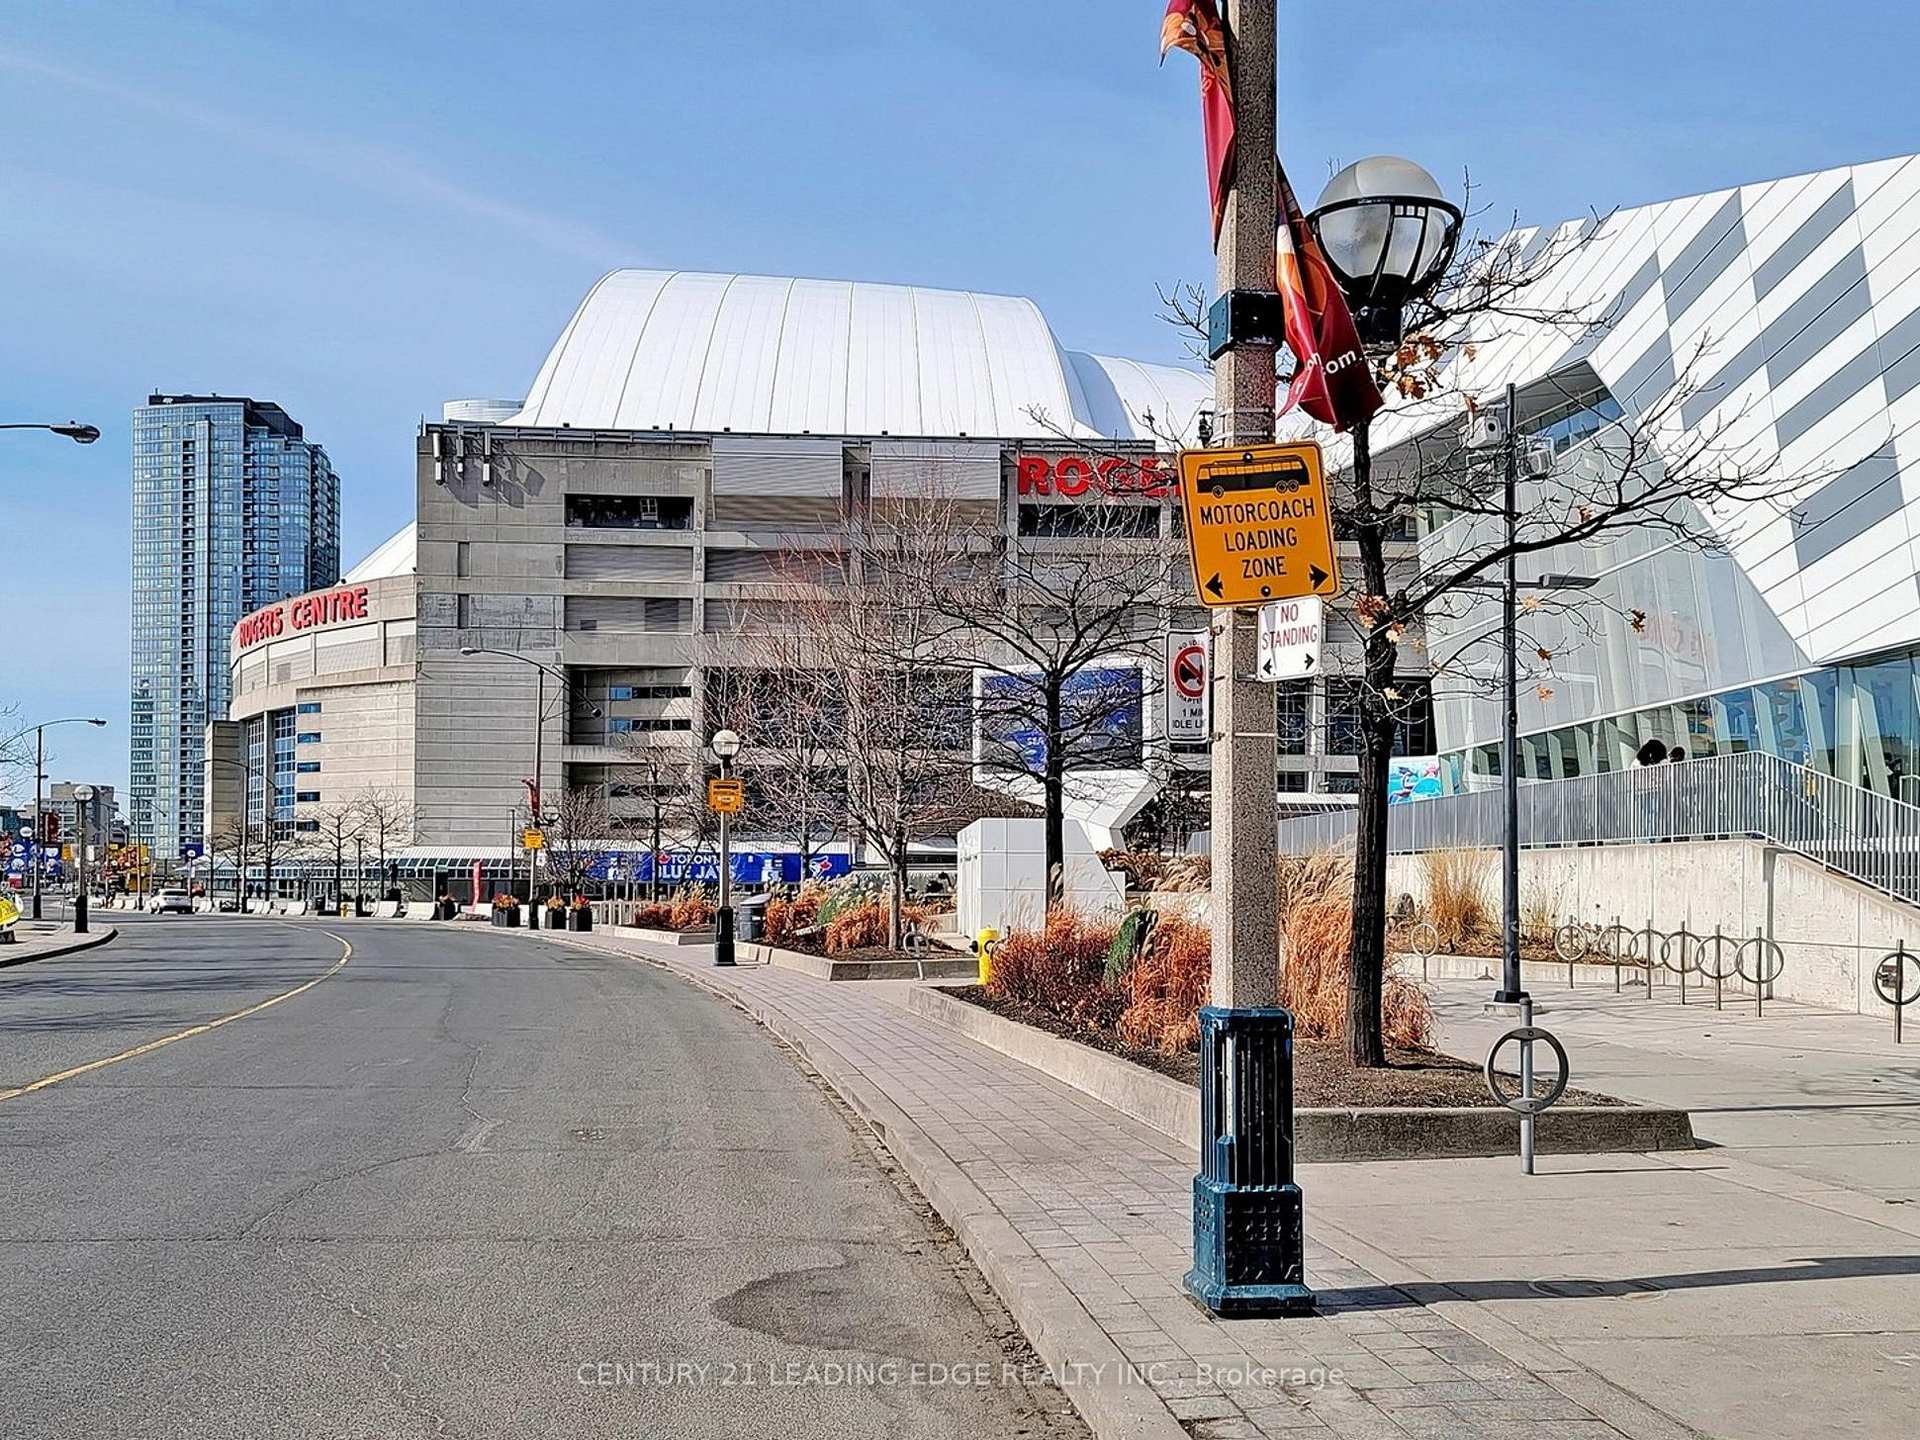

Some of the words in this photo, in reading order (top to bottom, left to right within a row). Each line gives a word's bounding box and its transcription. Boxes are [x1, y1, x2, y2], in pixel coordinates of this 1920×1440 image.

[1200, 498, 1316, 526] MOTORCOACH
[1224, 527, 1298, 552] LOADING
[1242, 556, 1287, 579] ZONE
[239, 607, 283, 648] ROGERS
[291, 587, 369, 631] CENTRE
[1281, 603, 1299, 624] NO
[1262, 624, 1318, 650] STANDING
[671, 854, 721, 865] TORONT
